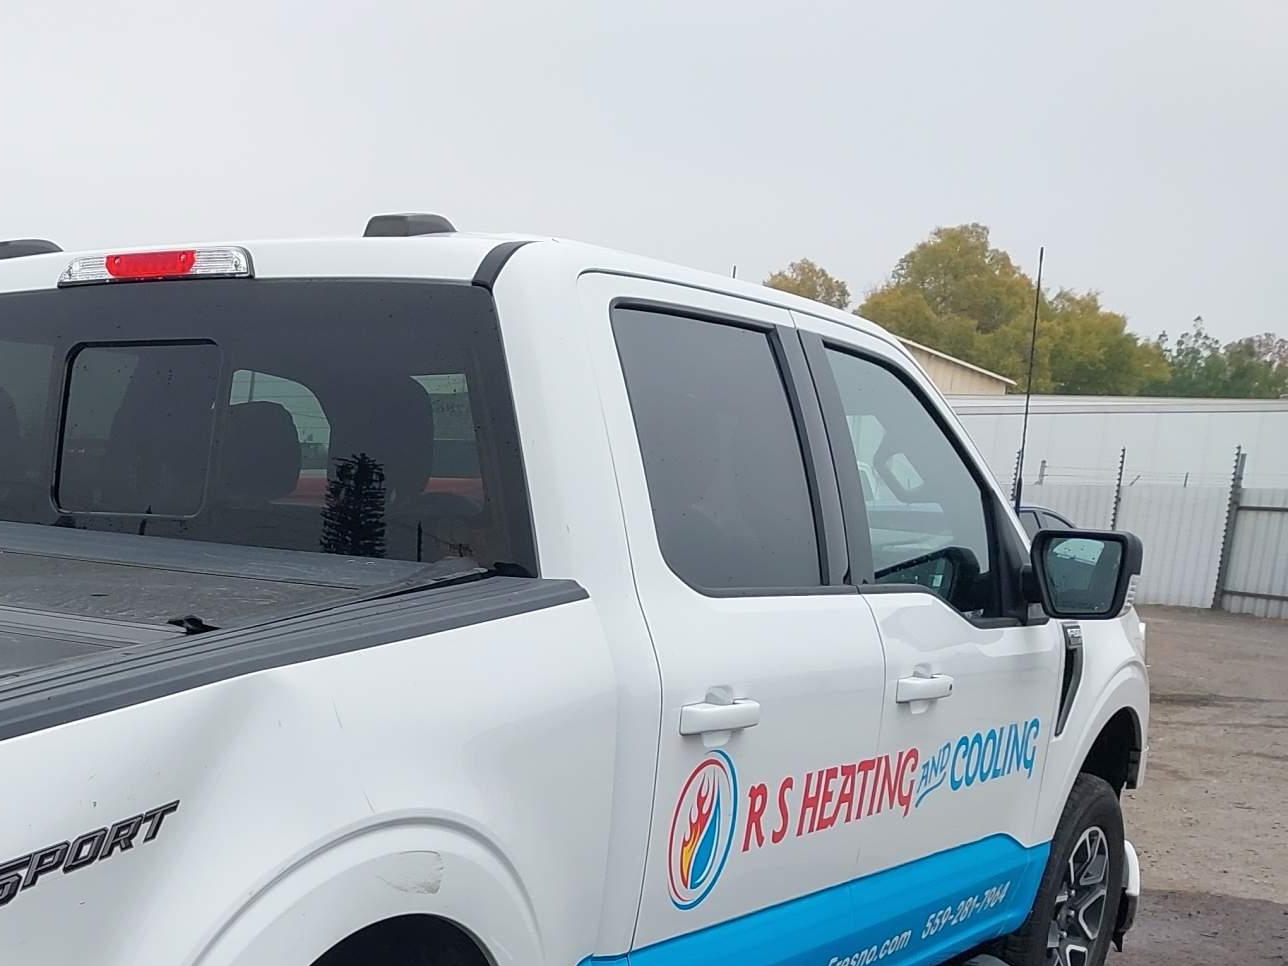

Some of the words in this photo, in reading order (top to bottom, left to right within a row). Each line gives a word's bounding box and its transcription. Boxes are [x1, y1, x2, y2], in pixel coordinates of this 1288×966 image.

[742, 784, 768, 852] R
[772, 777, 794, 843] S
[796, 747, 919, 836] HEATING
[919, 743, 950, 790] AND
[950, 717, 1042, 792] COOLING
[920, 881, 1010, 941] 559-281-7964
